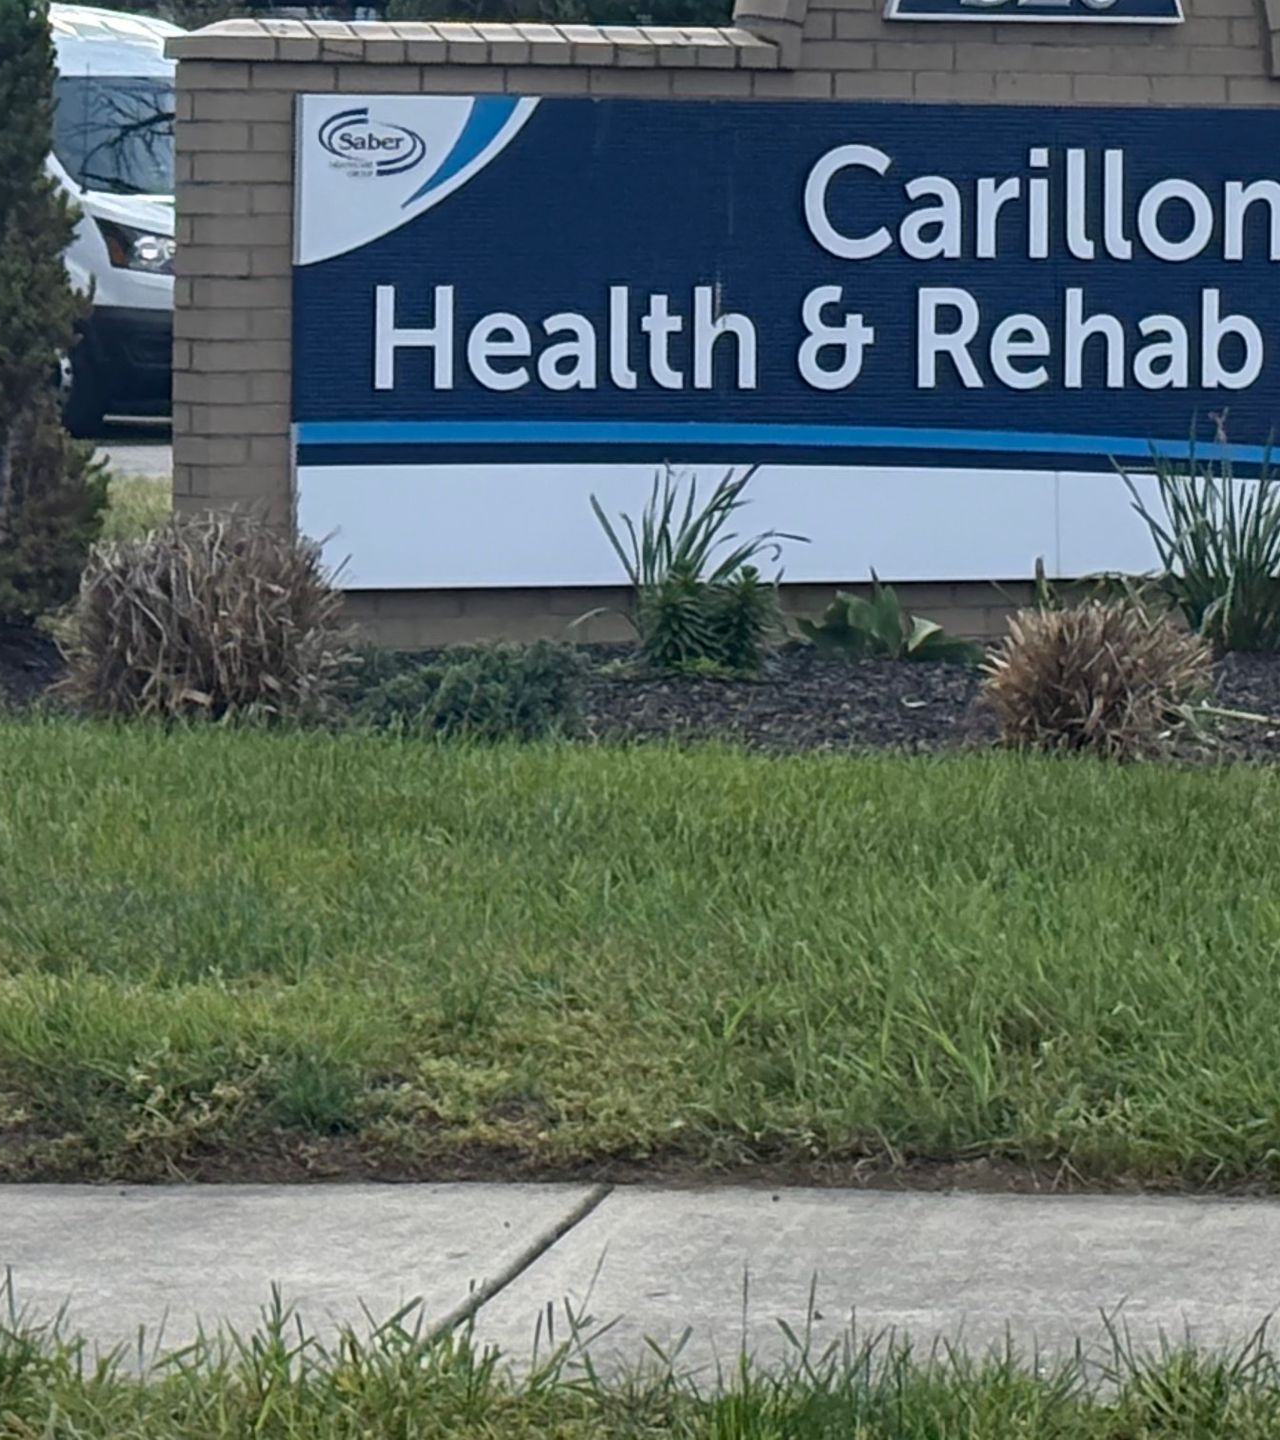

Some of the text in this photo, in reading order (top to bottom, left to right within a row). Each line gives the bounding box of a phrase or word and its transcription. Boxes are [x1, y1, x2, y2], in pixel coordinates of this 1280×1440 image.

[338, 133, 404, 152] Saber
[374, 284, 757, 391] Health
[797, 284, 875, 391] &
[917, 286, 1263, 391] Rehab
